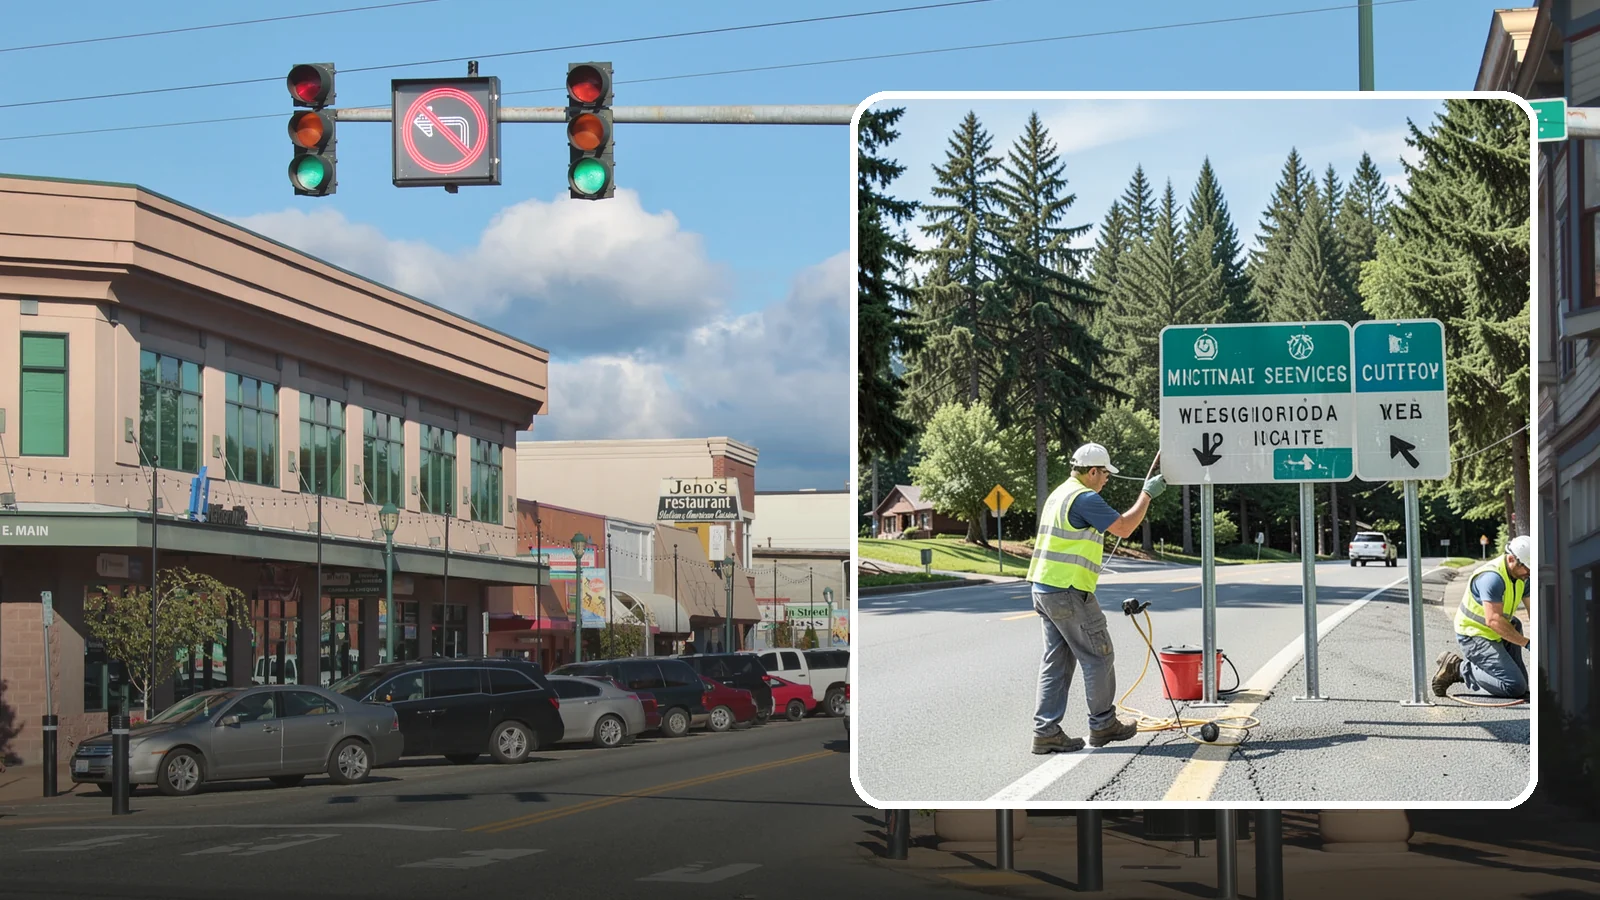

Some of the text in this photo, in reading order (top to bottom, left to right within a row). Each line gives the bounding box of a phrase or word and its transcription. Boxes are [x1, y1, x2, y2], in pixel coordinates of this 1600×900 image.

[669, 480, 727, 494] Jeno's
[665, 496, 731, 509] restaurant
[659, 509, 681, 519] Italian
[686, 509, 714, 519] American
[715, 509, 737, 519] Cuisine
[2, 525, 49, 536] E. MAIN
[797, 607, 828, 617] Street
